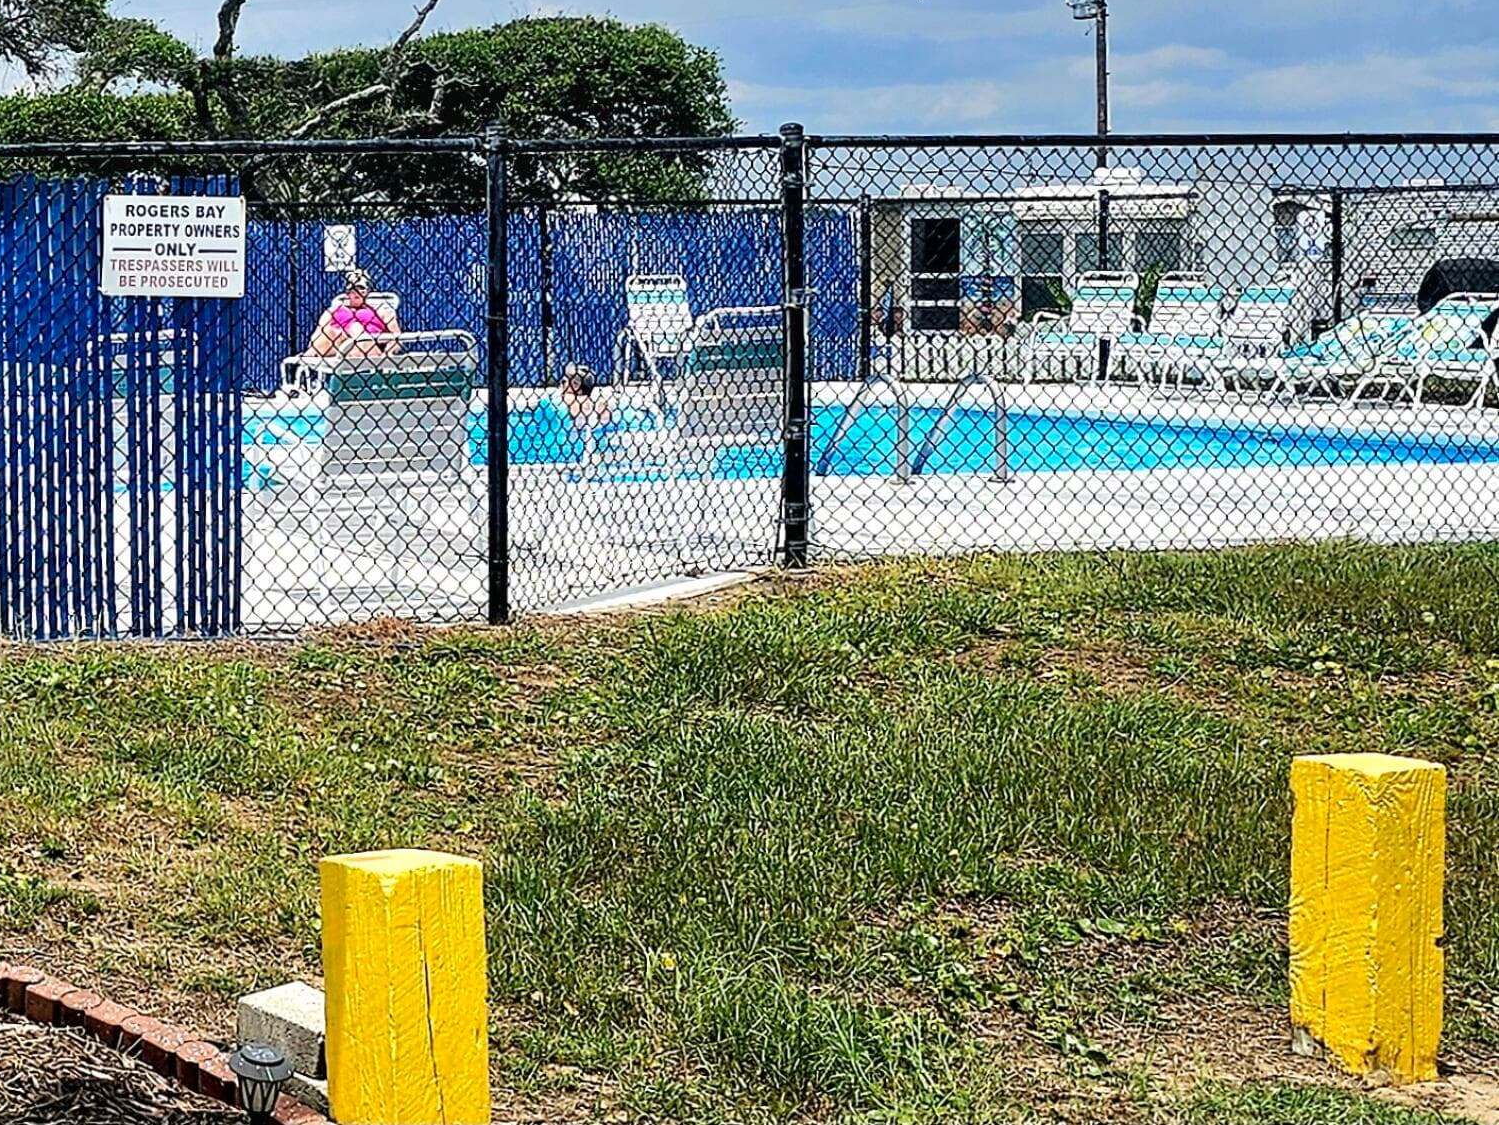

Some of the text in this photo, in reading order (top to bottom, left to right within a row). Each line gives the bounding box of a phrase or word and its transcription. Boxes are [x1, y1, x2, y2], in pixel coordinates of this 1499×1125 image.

[125, 204, 226, 219] ROGERS BAY
[110, 222, 241, 239] PROPERTY OWNERS
[154, 242, 197, 257] ONLY
[109, 258, 240, 273] TRESPASSERS WILL
[118, 275, 229, 289] BE PROSECUTED
